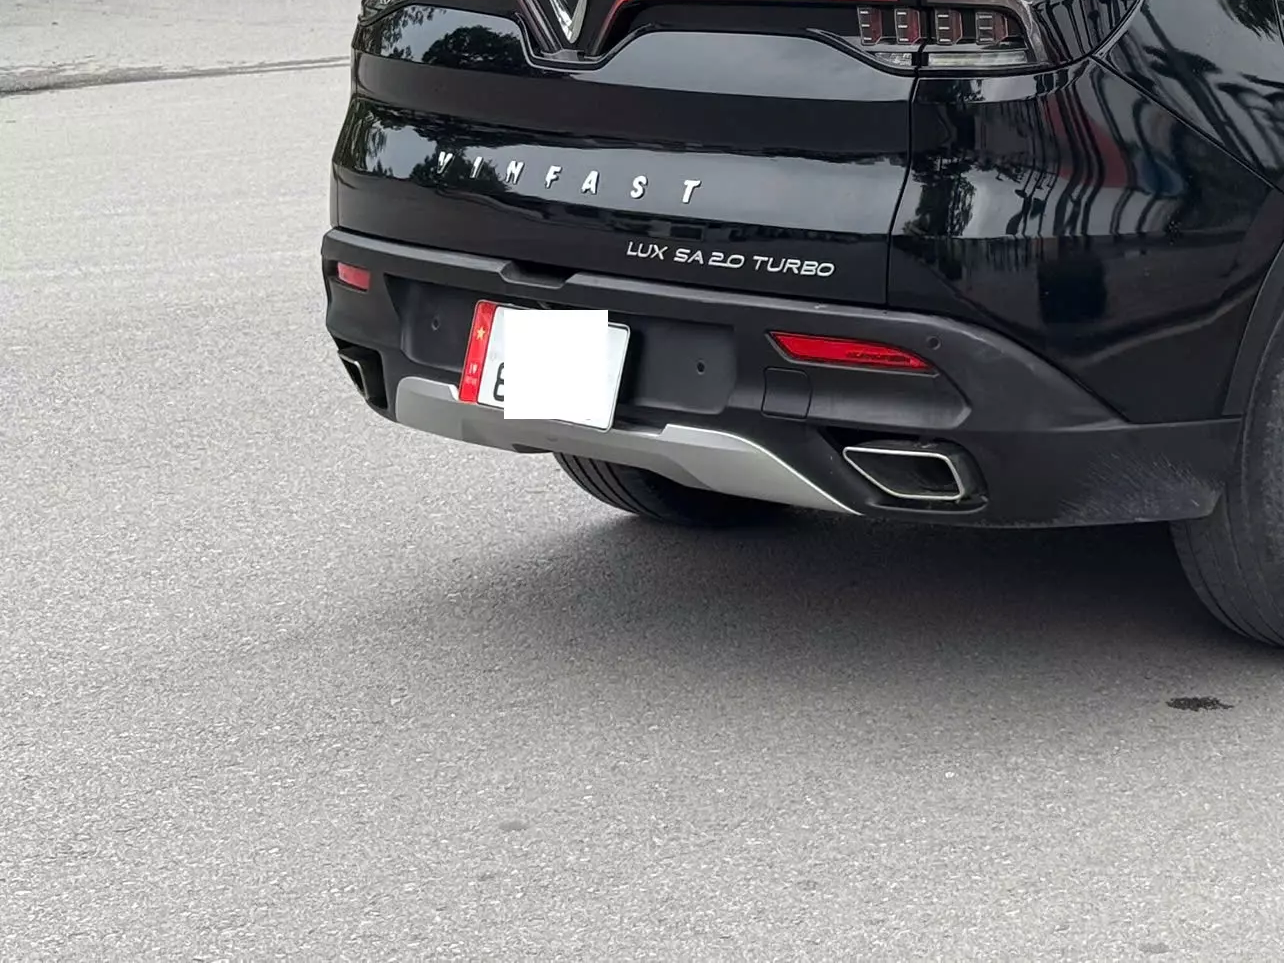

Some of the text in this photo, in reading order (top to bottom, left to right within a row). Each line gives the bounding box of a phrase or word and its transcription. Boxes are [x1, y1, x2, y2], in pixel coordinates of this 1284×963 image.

[437, 151, 701, 204] VINFAST
[626, 241, 668, 260] LUX
[752, 255, 835, 277] TURBO
